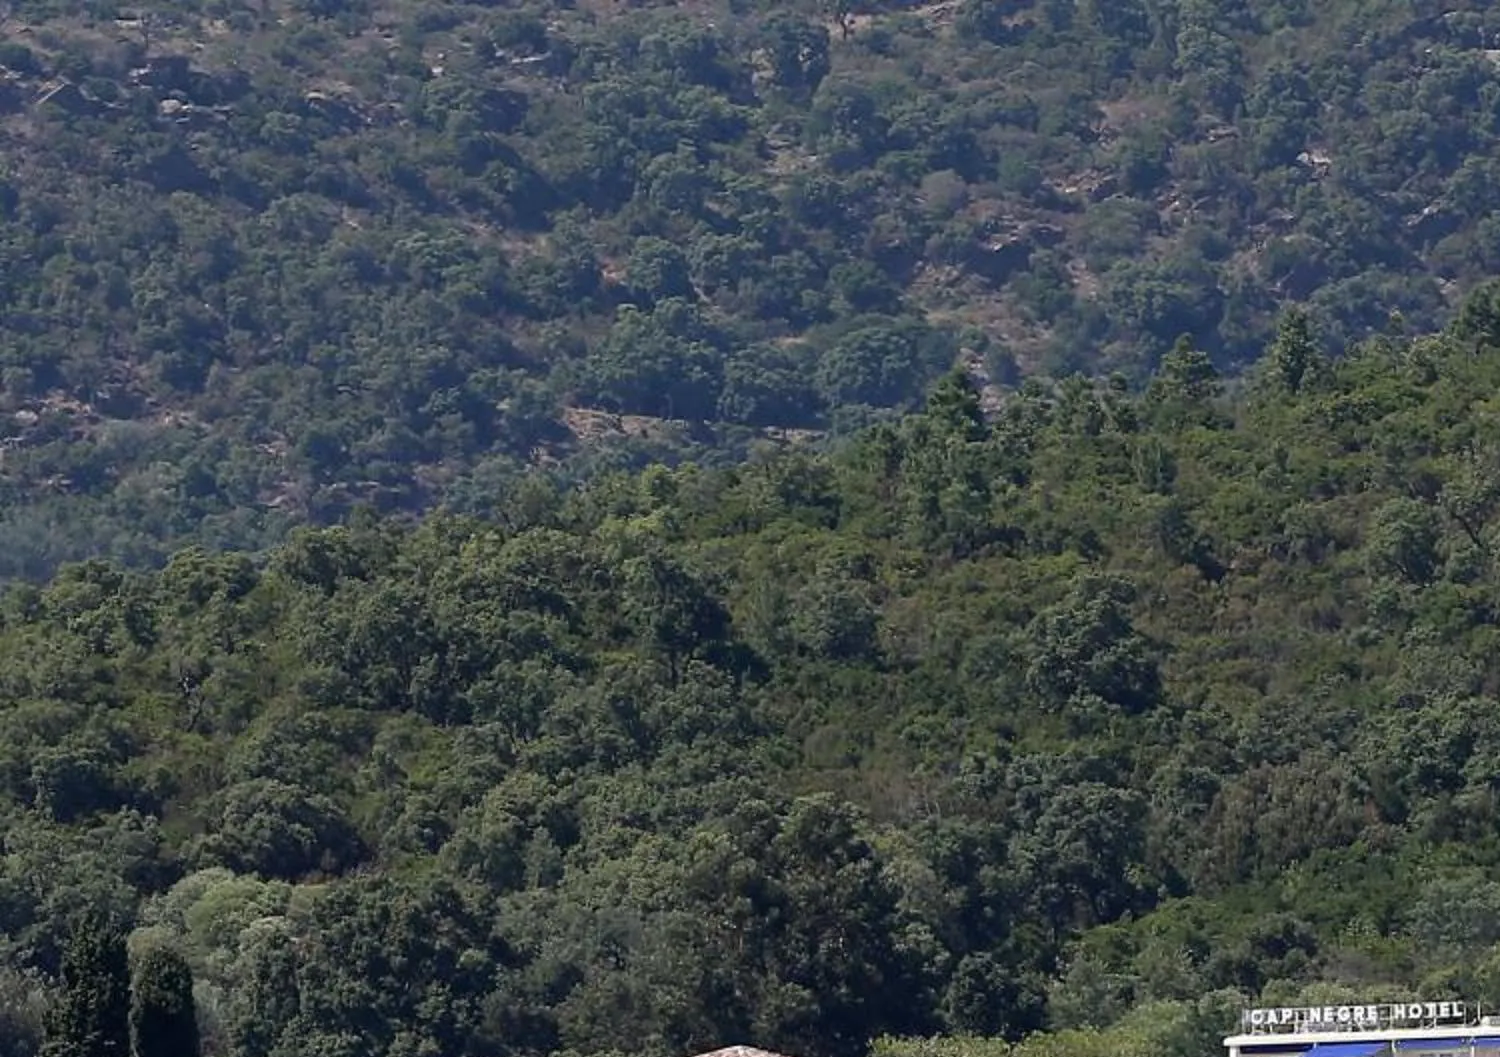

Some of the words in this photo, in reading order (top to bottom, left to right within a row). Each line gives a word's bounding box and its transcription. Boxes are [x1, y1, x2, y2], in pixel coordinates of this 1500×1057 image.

[1251, 1007, 1293, 1025] CAP
[1309, 1005, 1378, 1023] NEGRE
[1393, 1002, 1463, 1019] HOTEL
